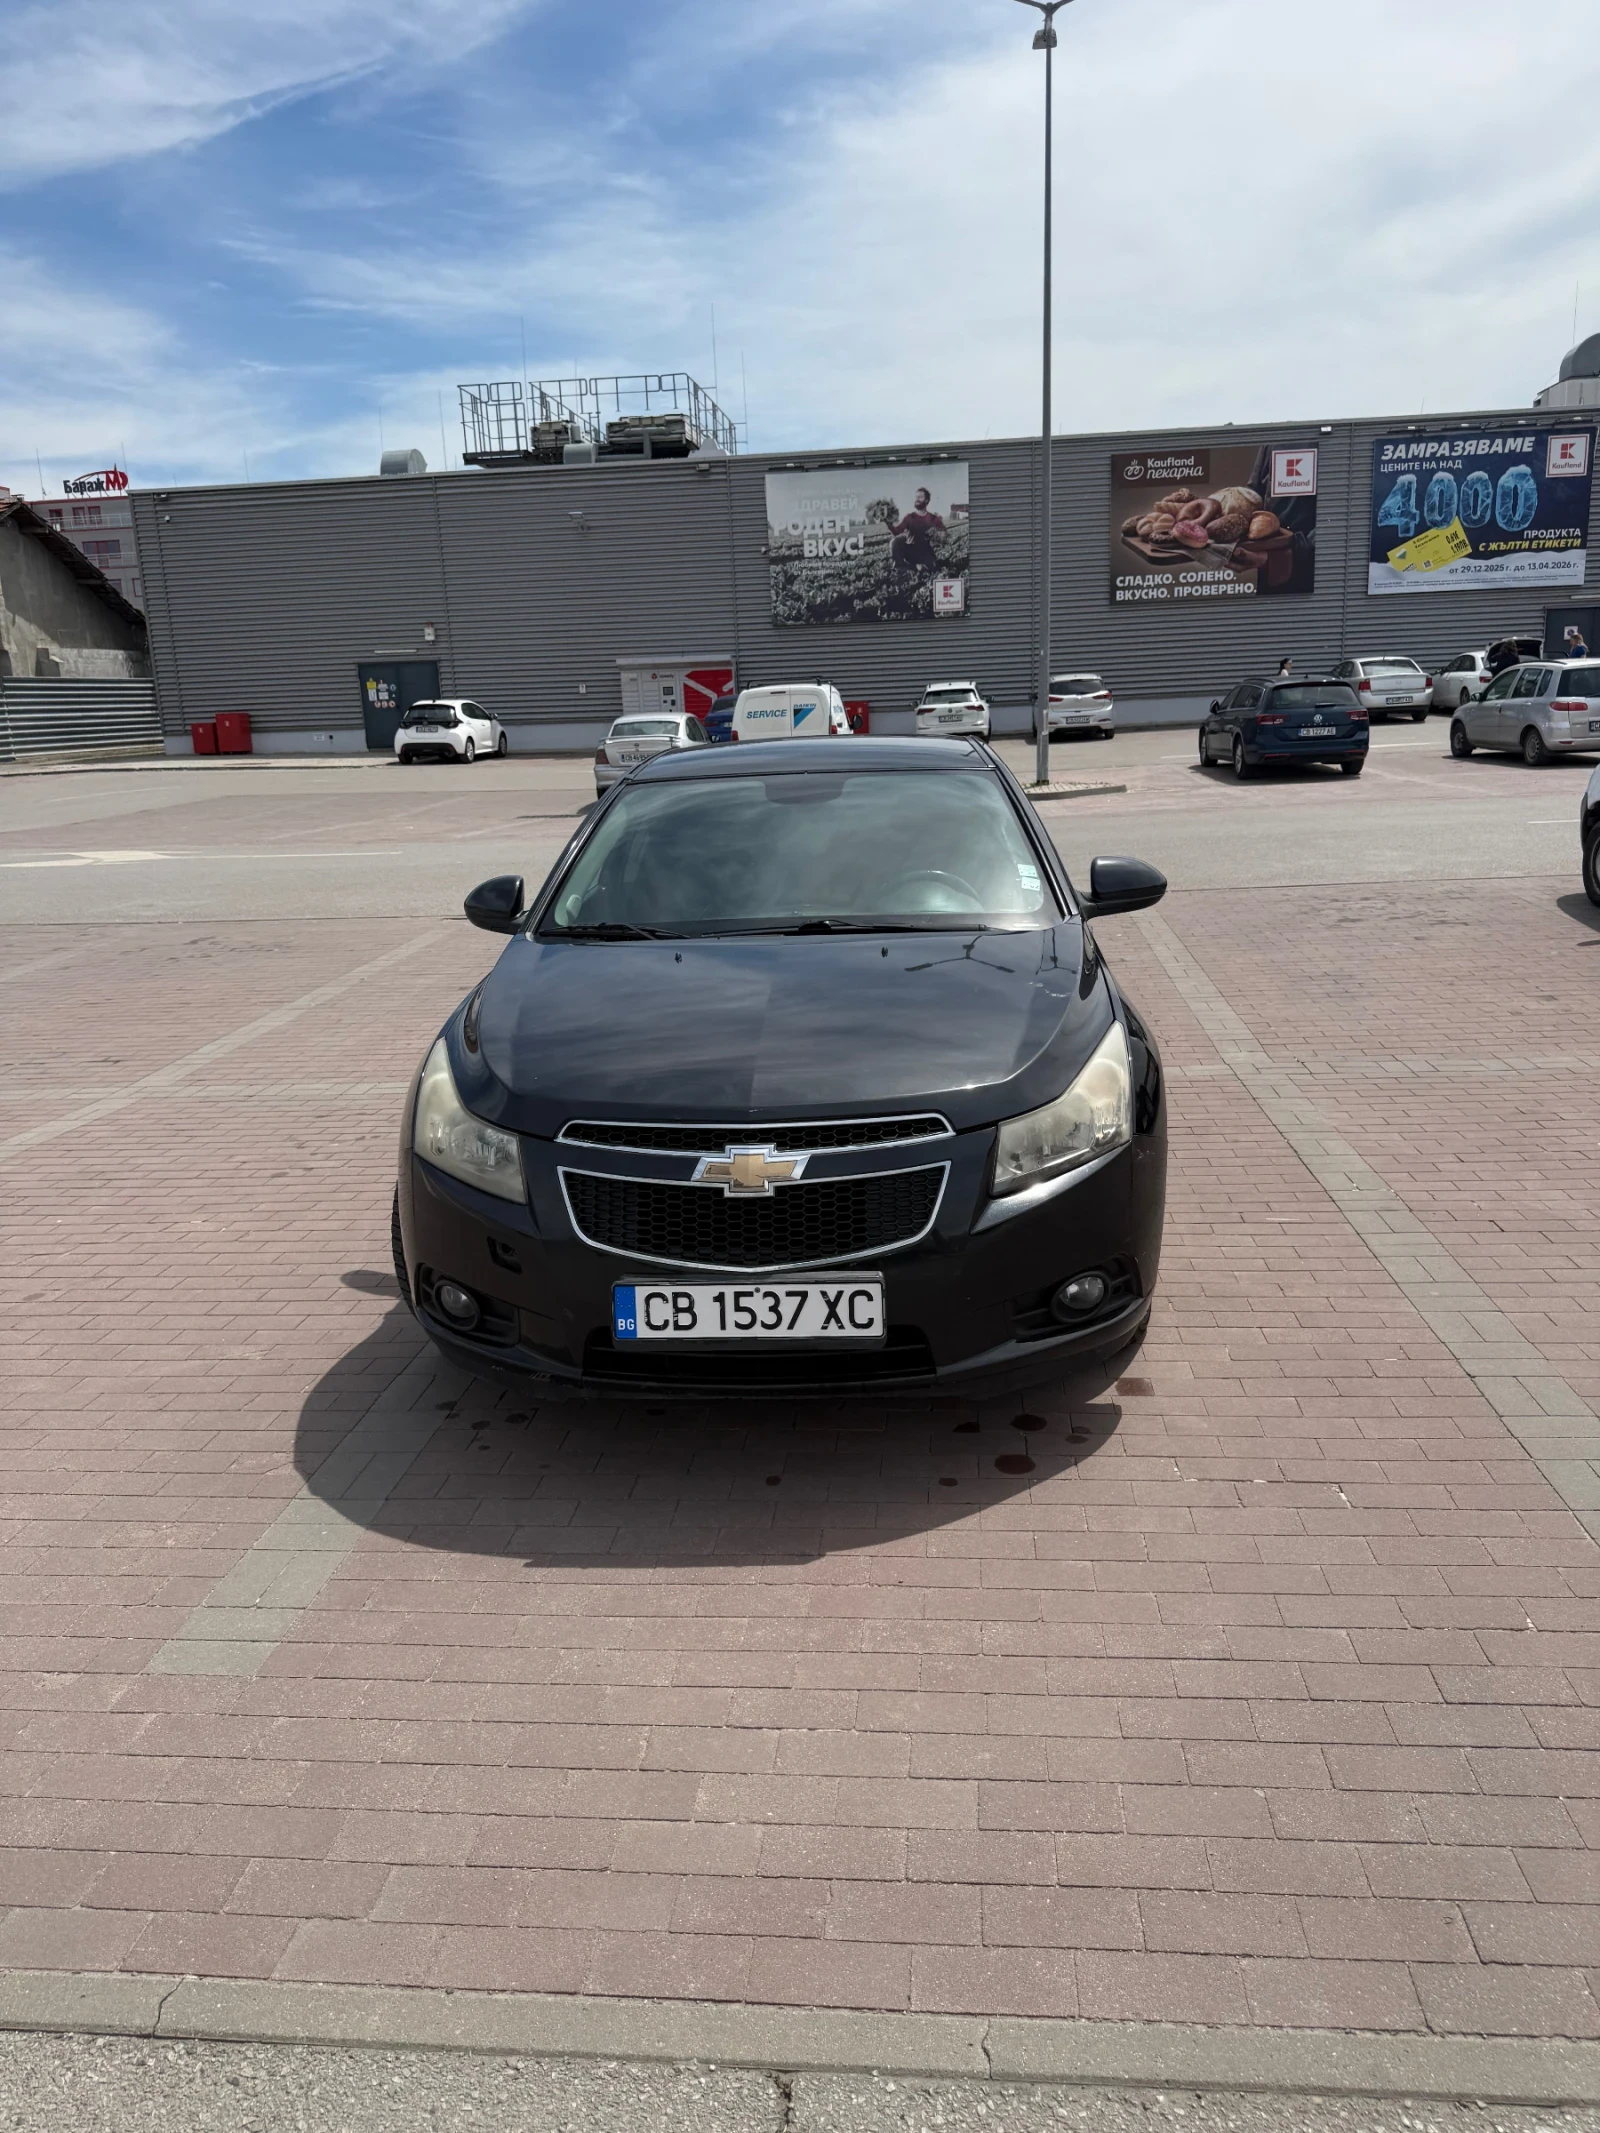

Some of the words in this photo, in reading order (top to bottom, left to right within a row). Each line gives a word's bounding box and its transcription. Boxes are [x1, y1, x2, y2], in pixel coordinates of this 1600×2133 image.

[1380, 436, 1536, 461] ЗАМРАЗЯВАМЕ
[1147, 456, 1194, 468] Kaufland
[1380, 461, 1421, 473] ЦЕНИТЕ
[1422, 460, 1437, 470] НА
[1439, 459, 1463, 470] НАД
[1552, 462, 1582, 470] Kaufland
[1146, 465, 1204, 480] пекарна
[63, 478, 105, 496] Бараж
[1277, 479, 1311, 488] Kaufland
[1378, 464, 1538, 537] 4000
[1523, 528, 1582, 540] ПРОДУКТА
[803, 533, 865, 558] ВКУС!
[1478, 542, 1486, 551] С
[1488, 541, 1530, 551] ЖЪЛТИ
[1530, 538, 1582, 549] ЕТИКЕТИ
[1461, 564, 1505, 574] 29.12.2025
[1513, 565, 1526, 573] до
[1527, 561, 1571, 571] 13.04.2026
[1116, 574, 1176, 588] СЛАДКО.
[1179, 570, 1237, 583] СОЛЕНО.
[1115, 588, 1171, 601] ВКУСНО.
[1174, 583, 1257, 598] ПРОВЕРЕНО.
[746, 709, 788, 720] SERVICE
[618, 1319, 635, 1330] BG
[644, 1291, 698, 1331] CB
[712, 1290, 809, 1331] 1537
[819, 1290, 875, 1331] XC
